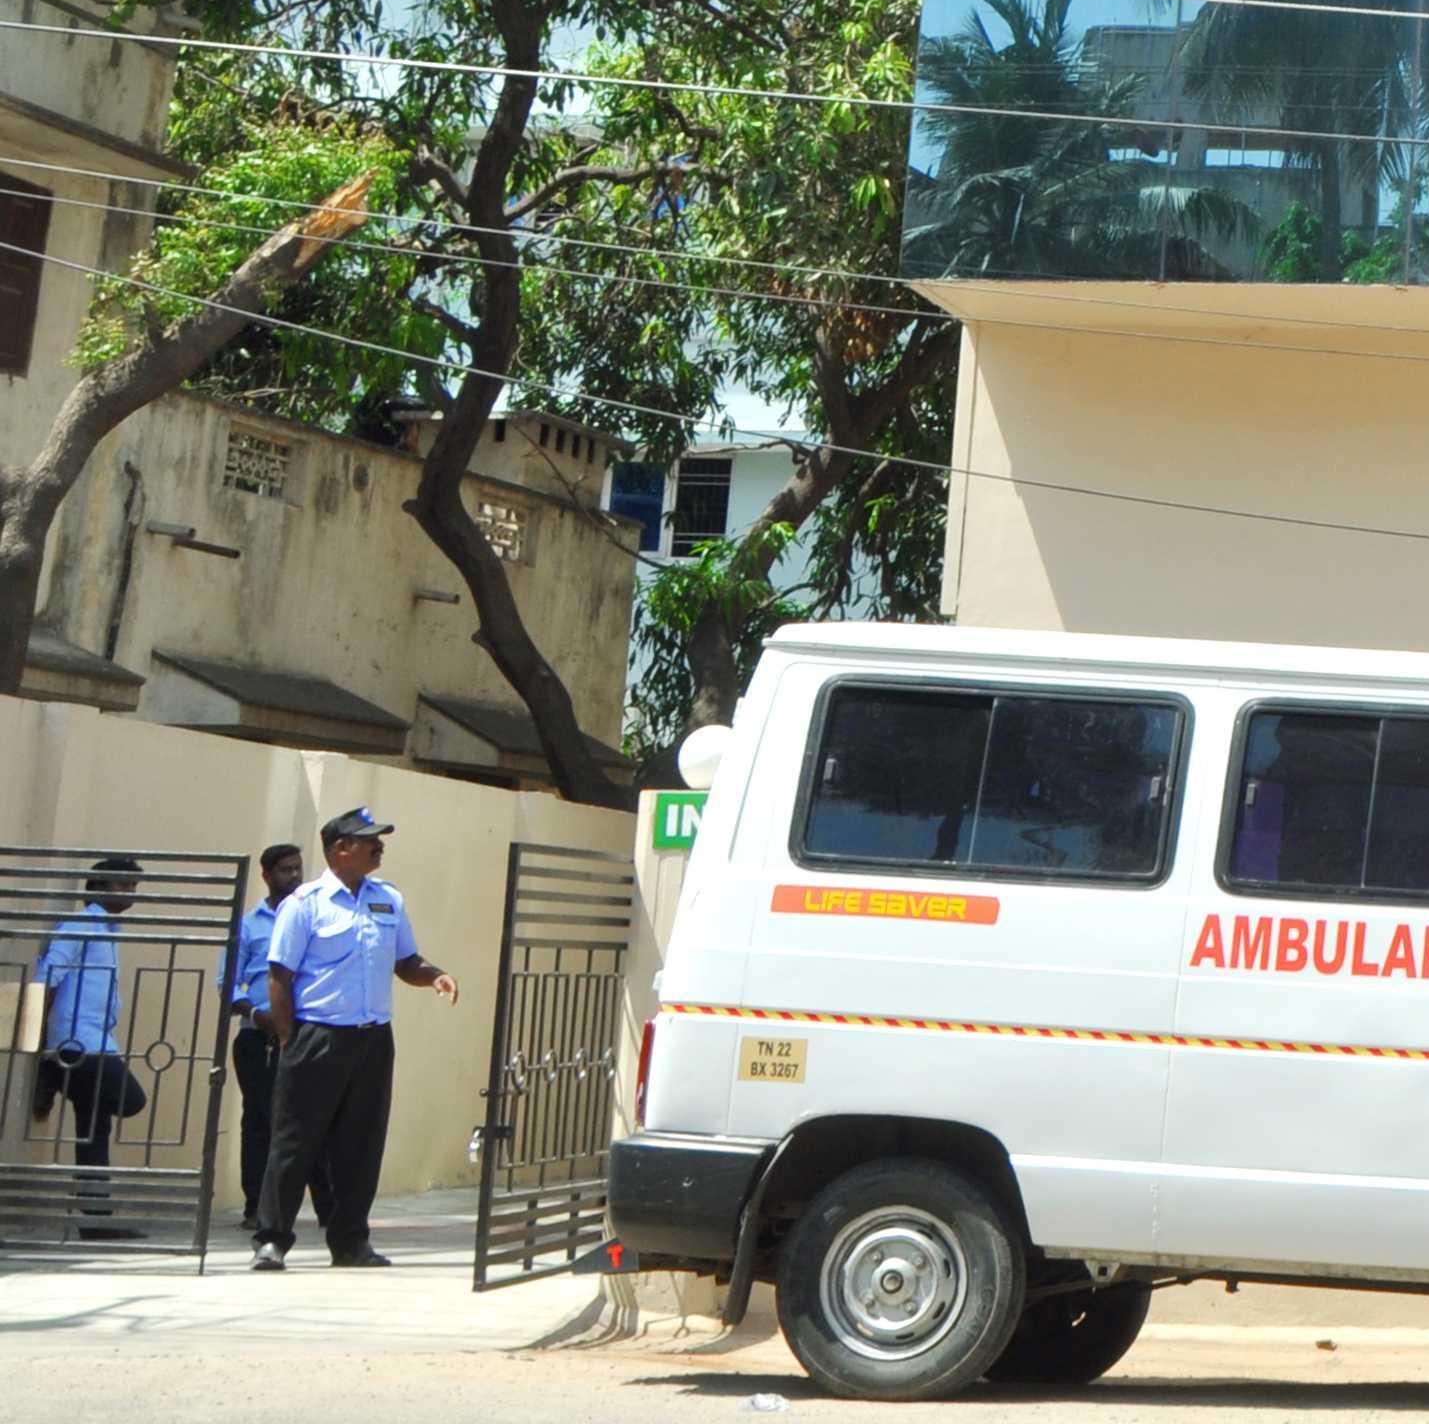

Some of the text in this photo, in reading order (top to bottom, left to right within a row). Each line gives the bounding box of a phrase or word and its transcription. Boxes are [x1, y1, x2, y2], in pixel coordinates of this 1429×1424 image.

[803, 888, 863, 913] LIFE
[757, 1041, 792, 1057] TN 22
[750, 1061, 799, 1079] BX 3267
